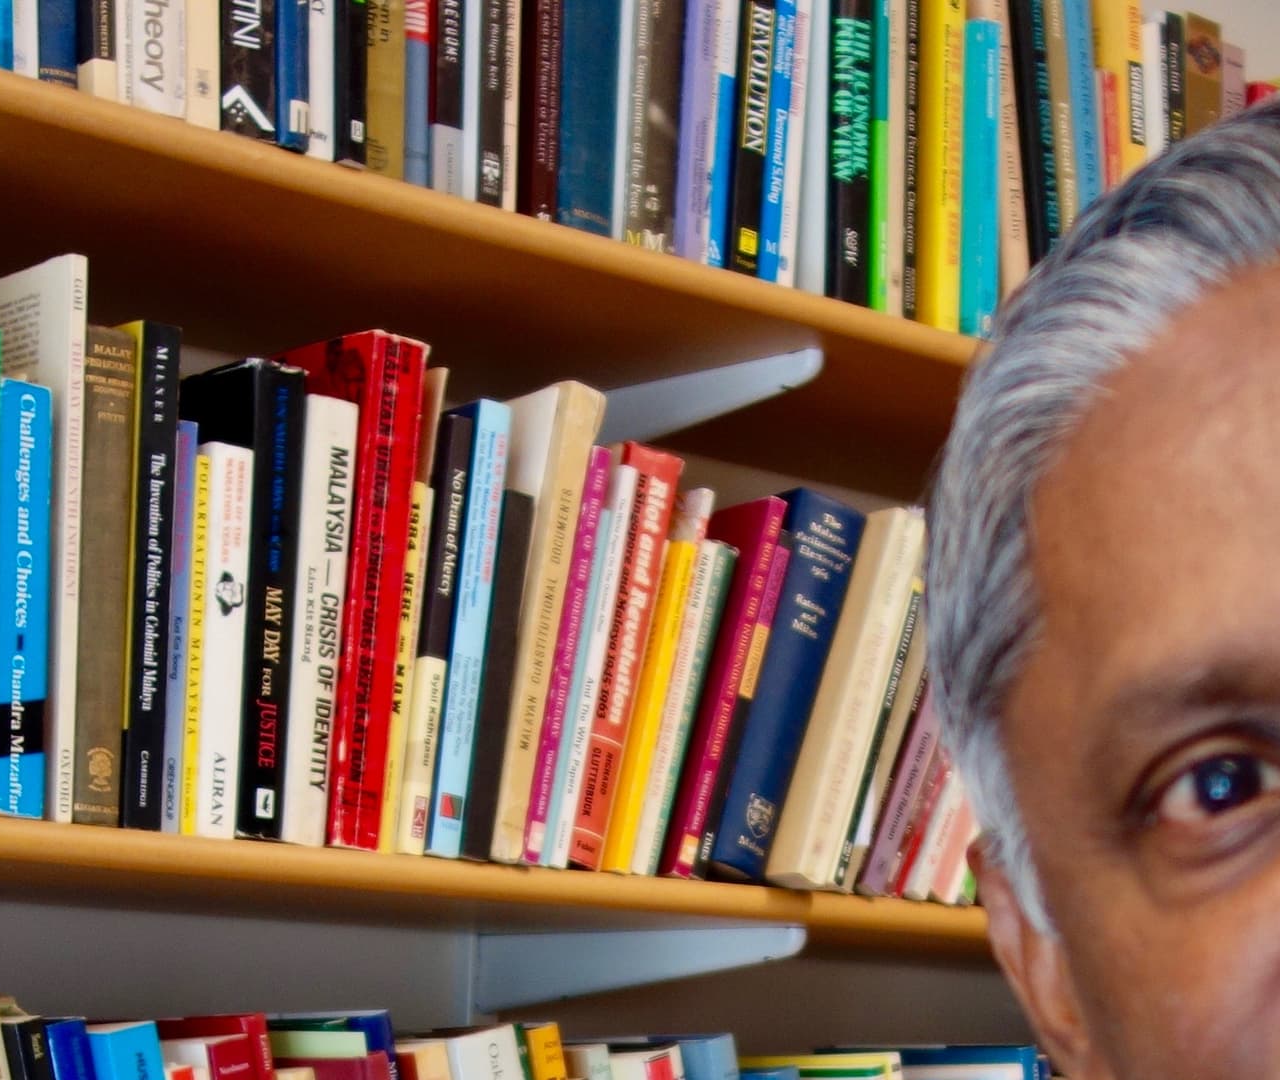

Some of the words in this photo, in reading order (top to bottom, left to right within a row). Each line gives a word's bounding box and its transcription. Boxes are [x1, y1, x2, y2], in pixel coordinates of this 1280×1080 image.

[141, 0, 167, 93] heory
[745, 6, 772, 152] REVOLUTION
[1130, 64, 1145, 145] SOVEREIGNTY
[773, 110, 787, 166] Desmond
[768, 178, 782, 204] King
[15, 393, 37, 503] Challenges
[17, 505, 34, 546] and
[323, 446, 349, 553] MALAYSIA
[407, 501, 421, 550] 1984
[640, 475, 670, 527] Riot
[633, 529, 654, 586] and
[15, 550, 33, 629] Choices
[265, 586, 283, 627] MAY
[400, 571, 415, 622] HERE
[263, 630, 282, 665] DAY
[318, 592, 339, 659] CRISIS
[261, 668, 272, 697] FOR
[316, 664, 335, 692] OF
[608, 587, 648, 725] Revolution
[391, 663, 406, 715] NOW
[256, 698, 277, 768] JUSTICE
[309, 695, 336, 793] IDENTITY
[210, 752, 227, 826] ALIRAN
[581, 747, 602, 817] CLUTTERBUCK
[598, 752, 614, 796] RICHARD
